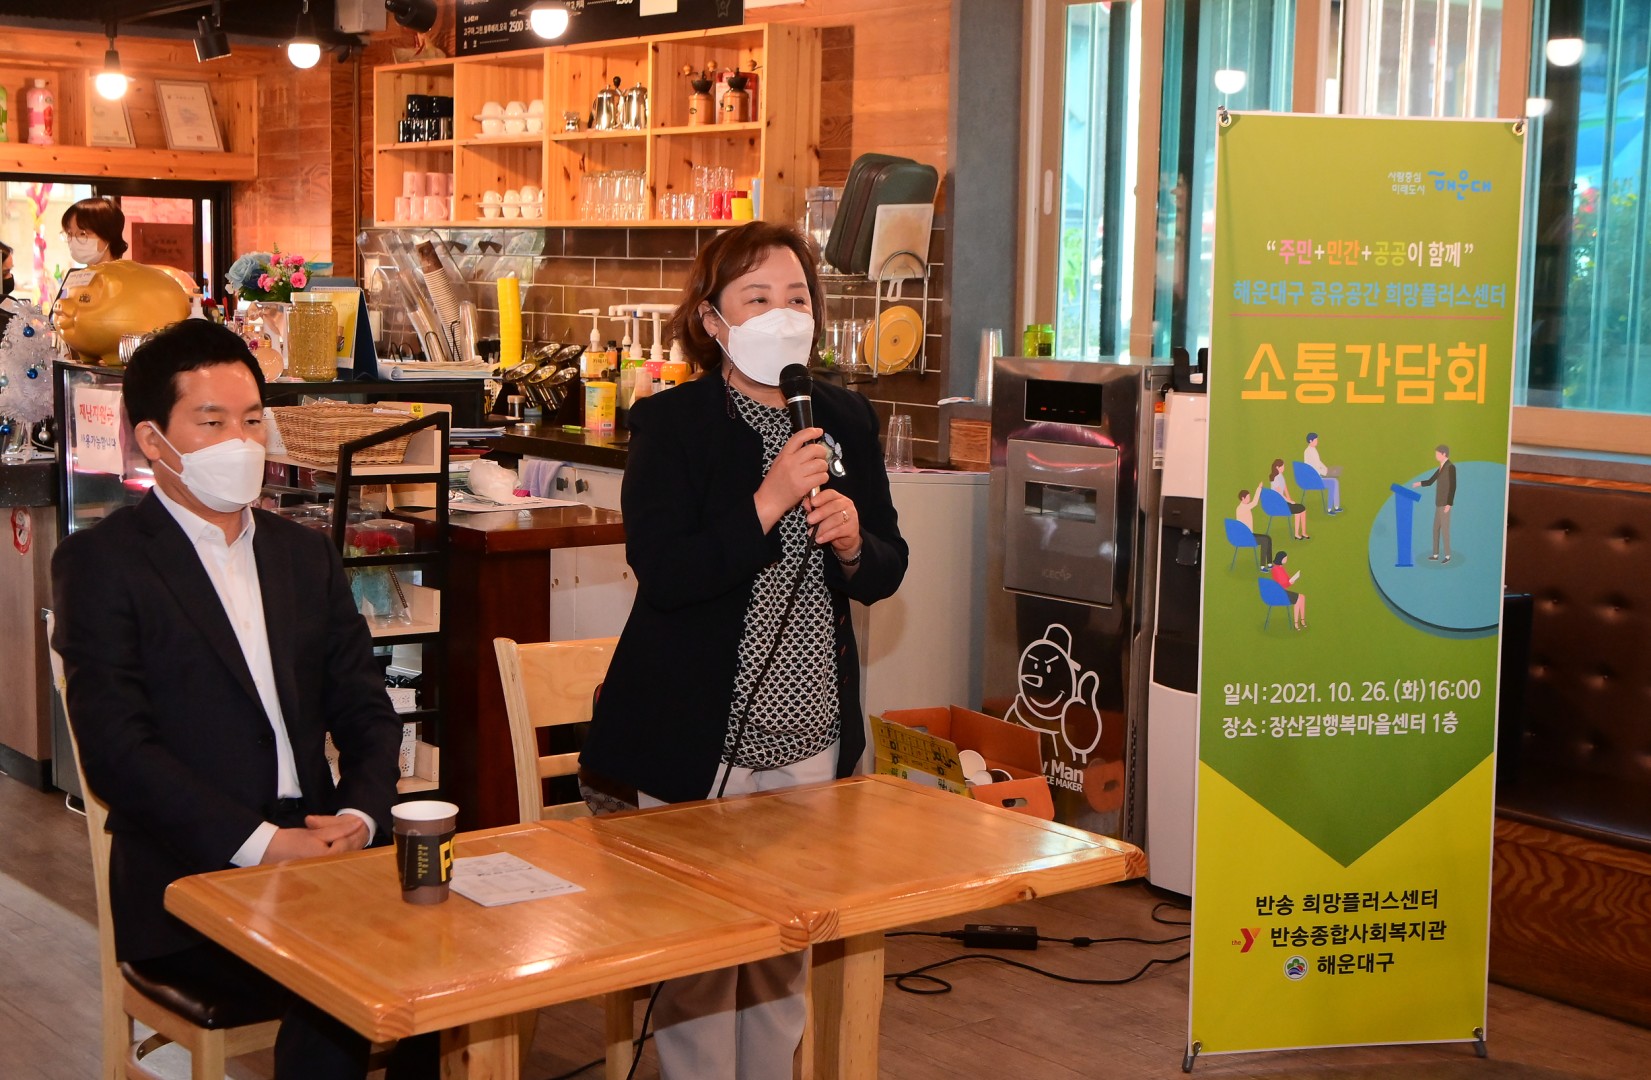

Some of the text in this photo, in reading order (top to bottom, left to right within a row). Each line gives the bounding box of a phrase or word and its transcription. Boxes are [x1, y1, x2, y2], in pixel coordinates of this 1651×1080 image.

[508, 20, 524, 33] 2500
[1388, 171, 1422, 184] 사람중심
[1427, 169, 1492, 201] 해운대
[1391, 184, 1426, 196] 미래도시
[1232, 279, 1506, 309] 해운대구 공유공간 희망플러스센터
[1240, 341, 1488, 405] 소통간담회
[1328, 681, 1355, 702] 10.
[1432, 710, 1459, 734] 1층
[1051, 759, 1084, 784] Man
[1055, 778, 1083, 793] MAKER
[1255, 888, 1439, 917] 반송 희망플러스센터
[1270, 920, 1447, 948] 반송종합사회복지관
[1317, 952, 1395, 976] 해운대구
